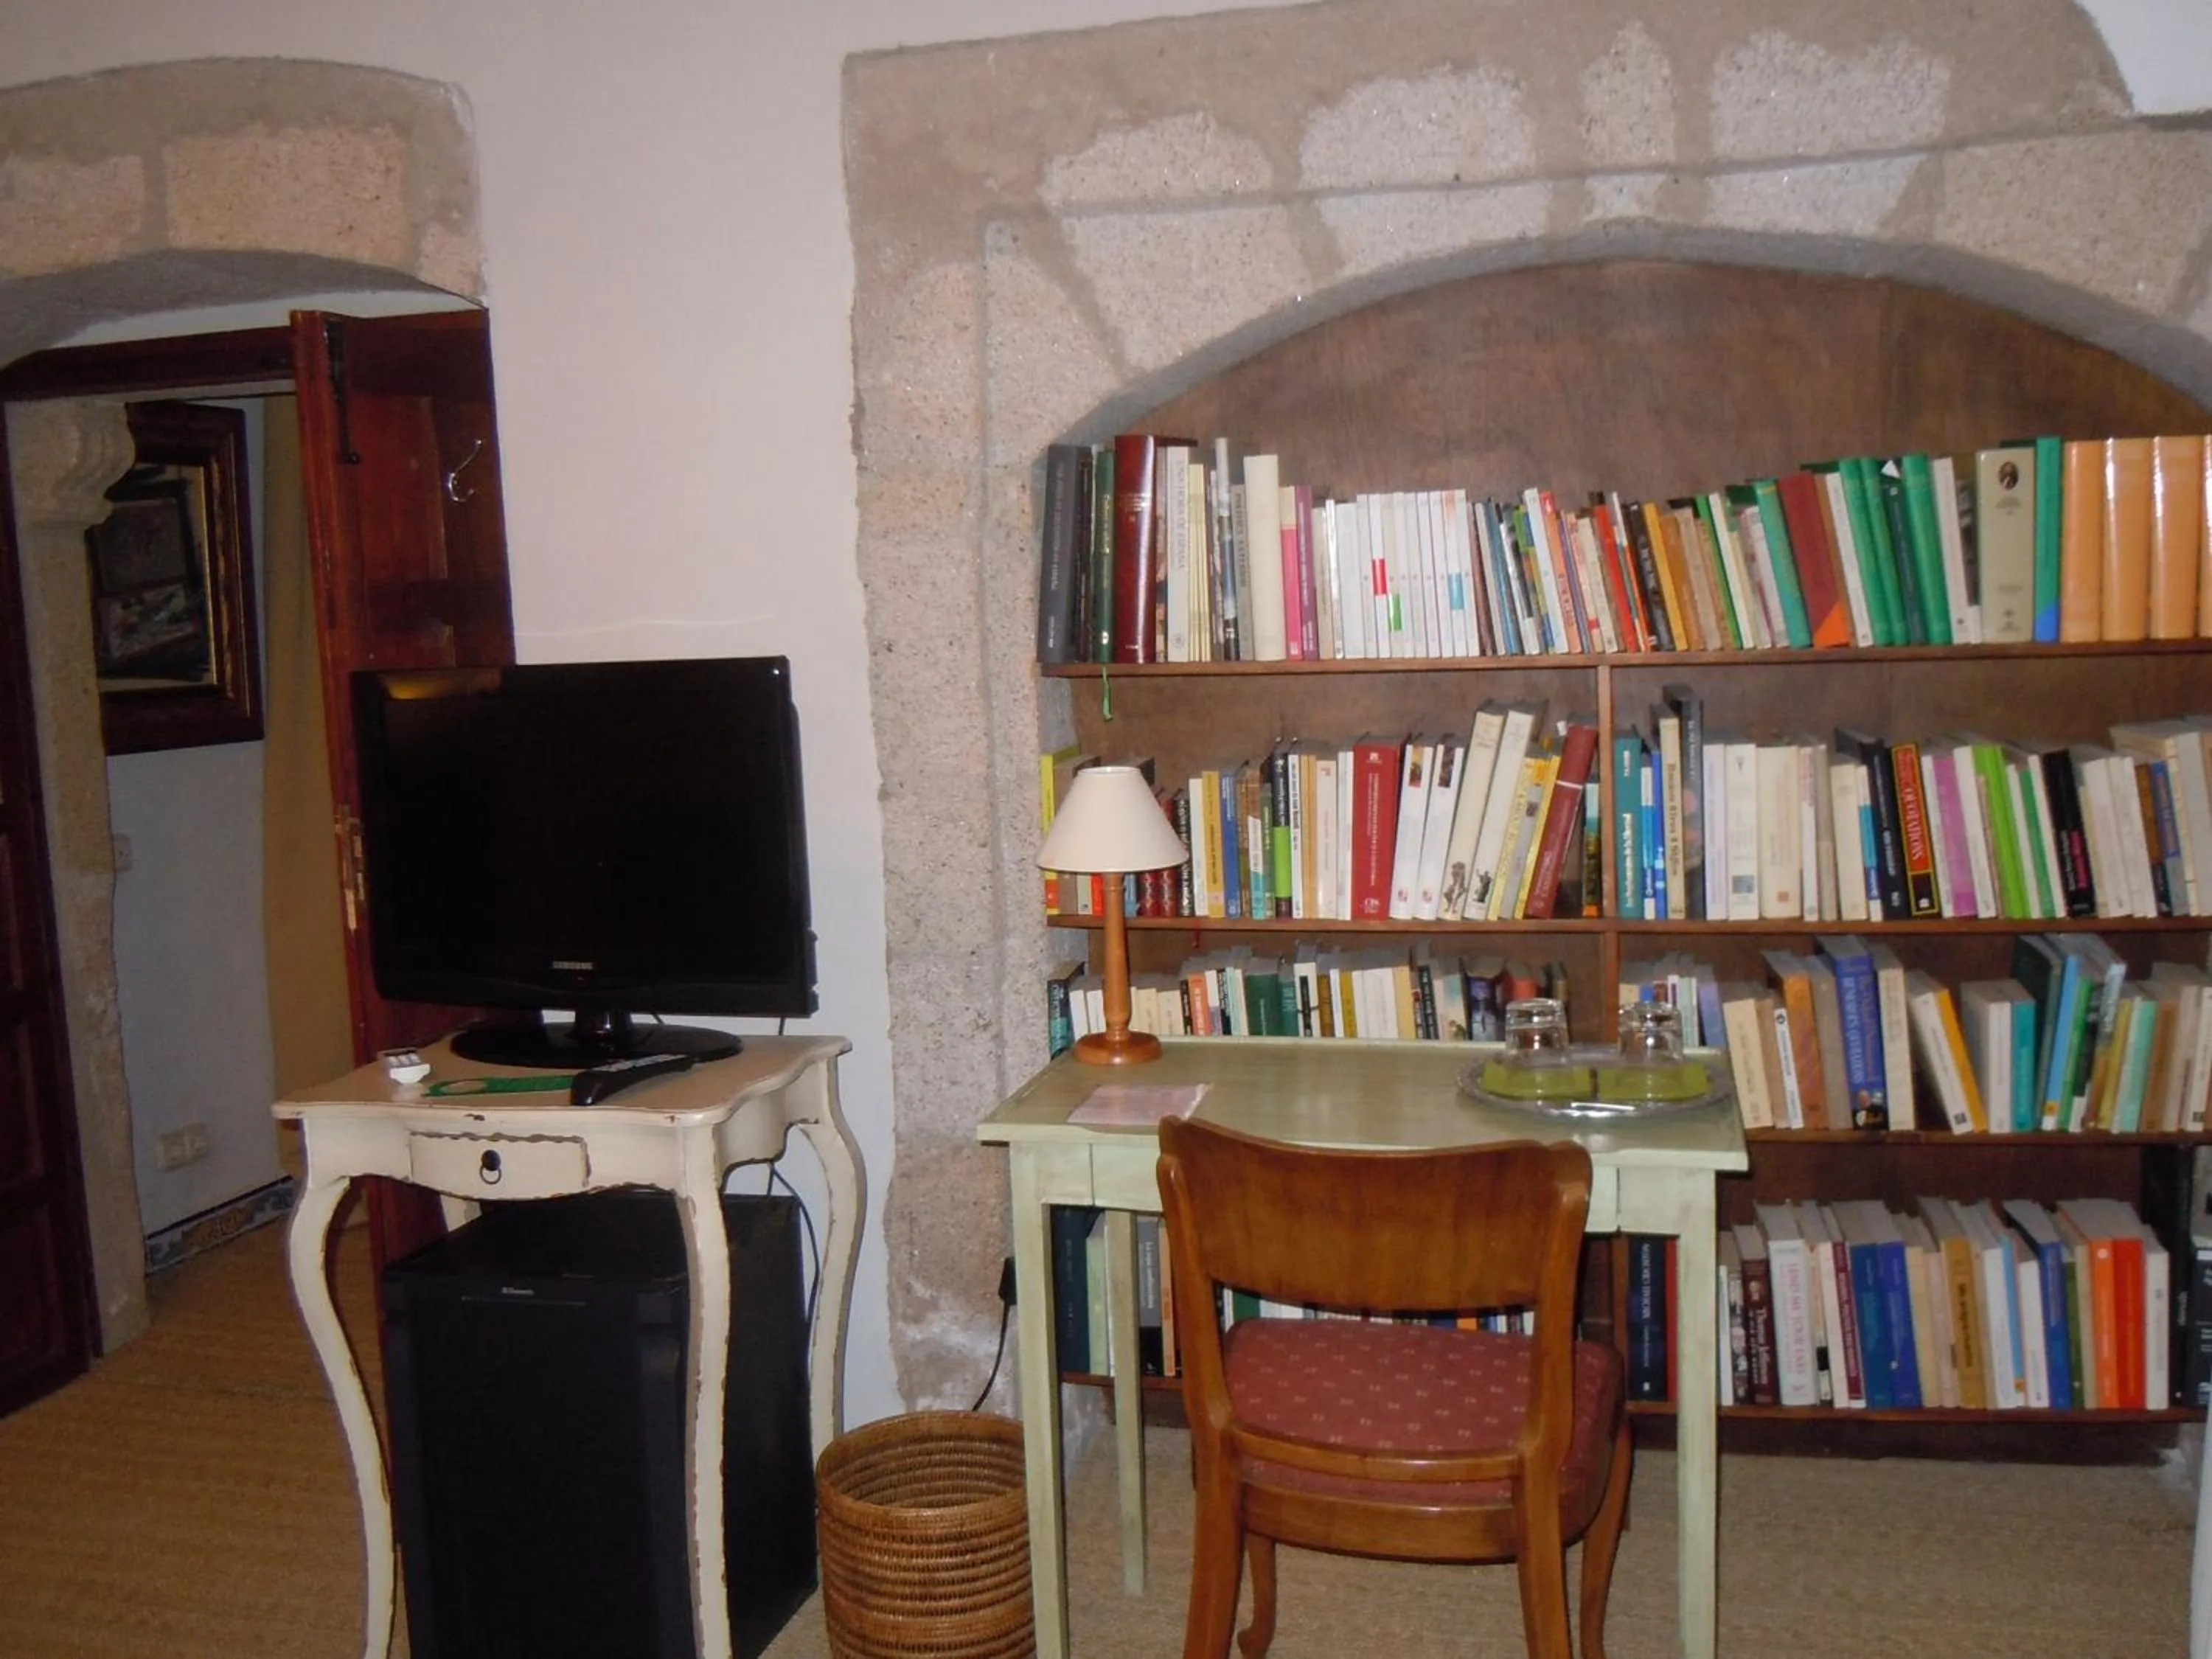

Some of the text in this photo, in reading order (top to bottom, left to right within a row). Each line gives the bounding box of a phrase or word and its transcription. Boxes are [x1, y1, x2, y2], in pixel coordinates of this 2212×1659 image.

[1902, 787, 1924, 860] QUOTATIONS
[1757, 1307, 1770, 1385] Thomas Jefferson
